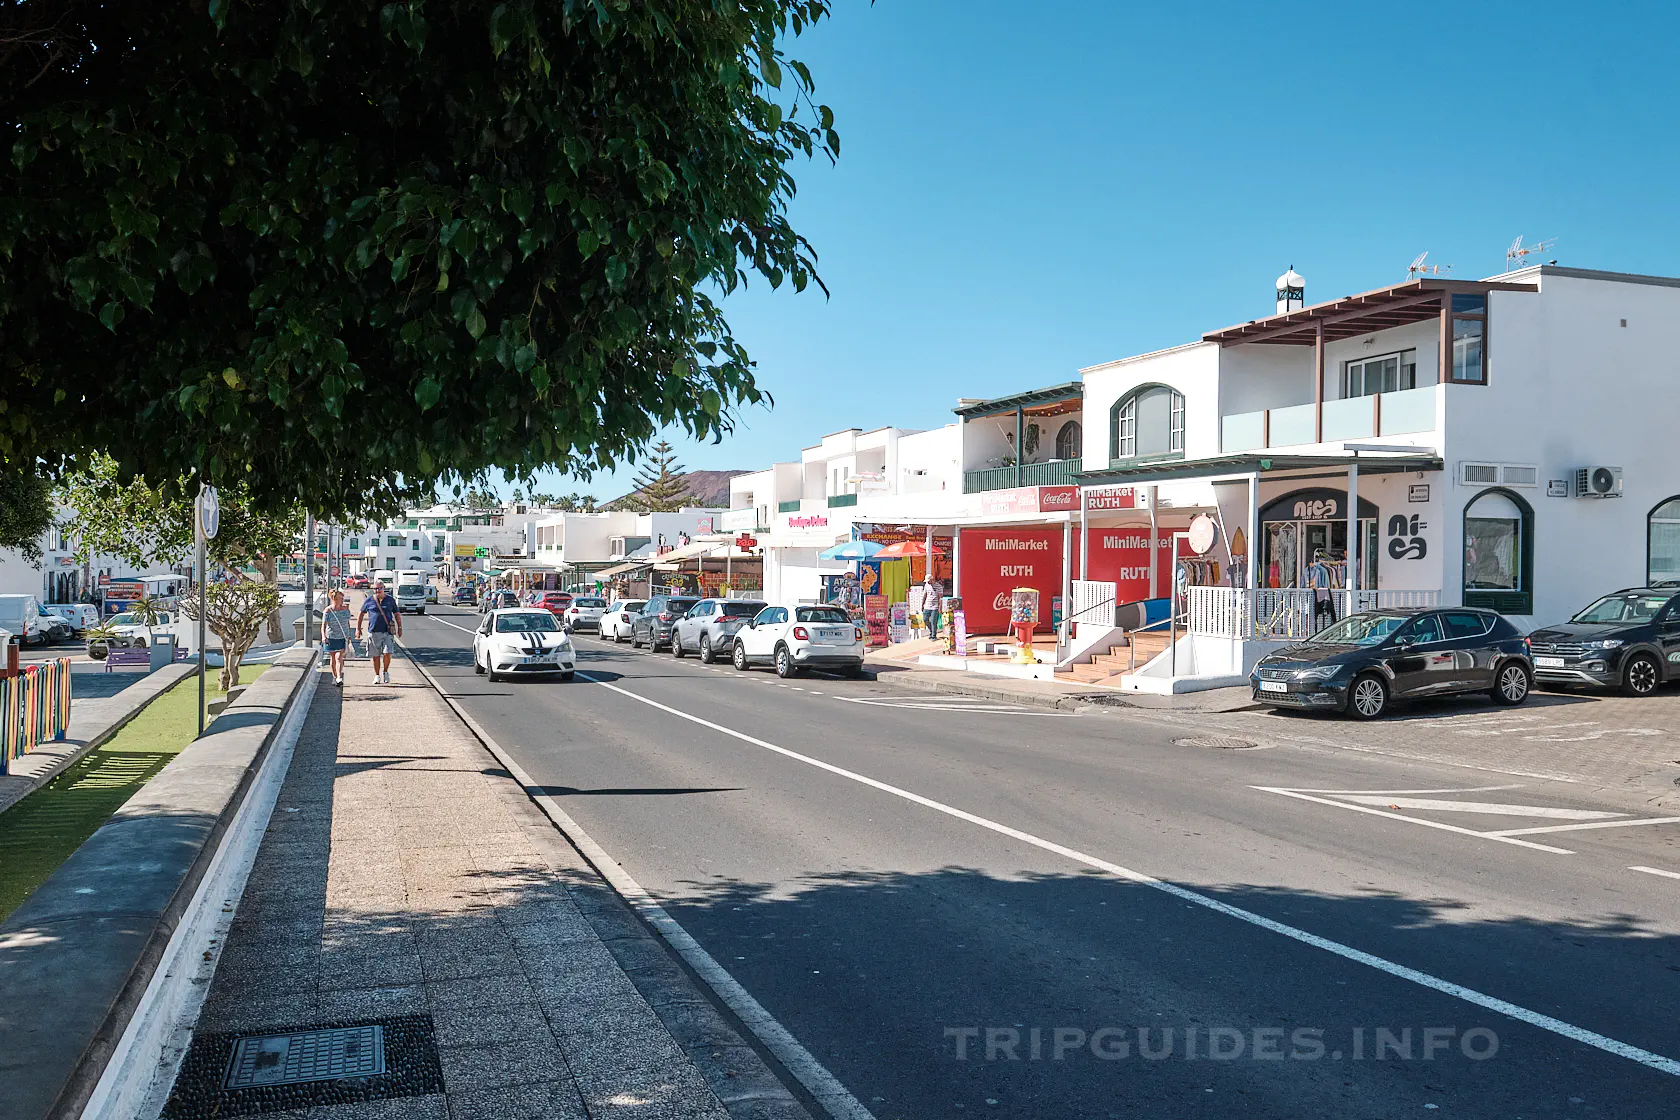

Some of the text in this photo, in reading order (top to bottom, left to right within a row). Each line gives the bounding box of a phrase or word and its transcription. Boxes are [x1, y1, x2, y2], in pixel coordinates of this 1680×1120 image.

[1076, 488, 1132, 499] MniMarket
[991, 503, 1009, 512] RUTH
[1088, 498, 1120, 508] RUTH
[985, 538, 1048, 550] MiniMarket
[1000, 565, 1033, 577] RUTH
